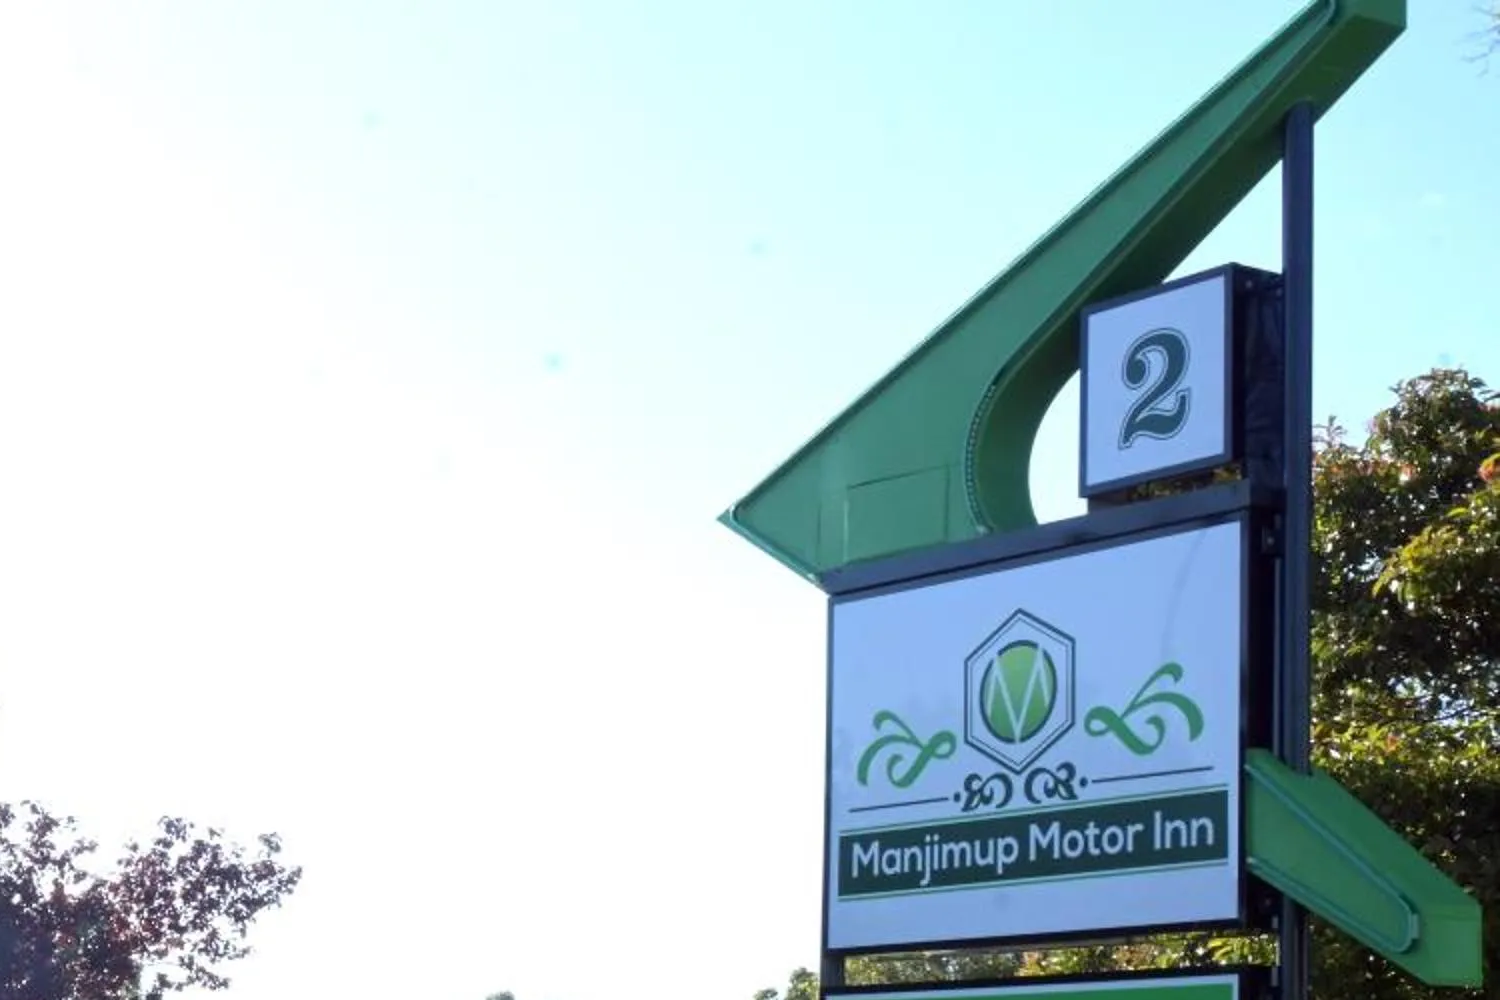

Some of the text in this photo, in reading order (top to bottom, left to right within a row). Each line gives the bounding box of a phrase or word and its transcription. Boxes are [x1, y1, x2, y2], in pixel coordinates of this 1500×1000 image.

[1118, 327, 1191, 450] 2
[851, 810, 1215, 886] Manjimup Motor Inn
